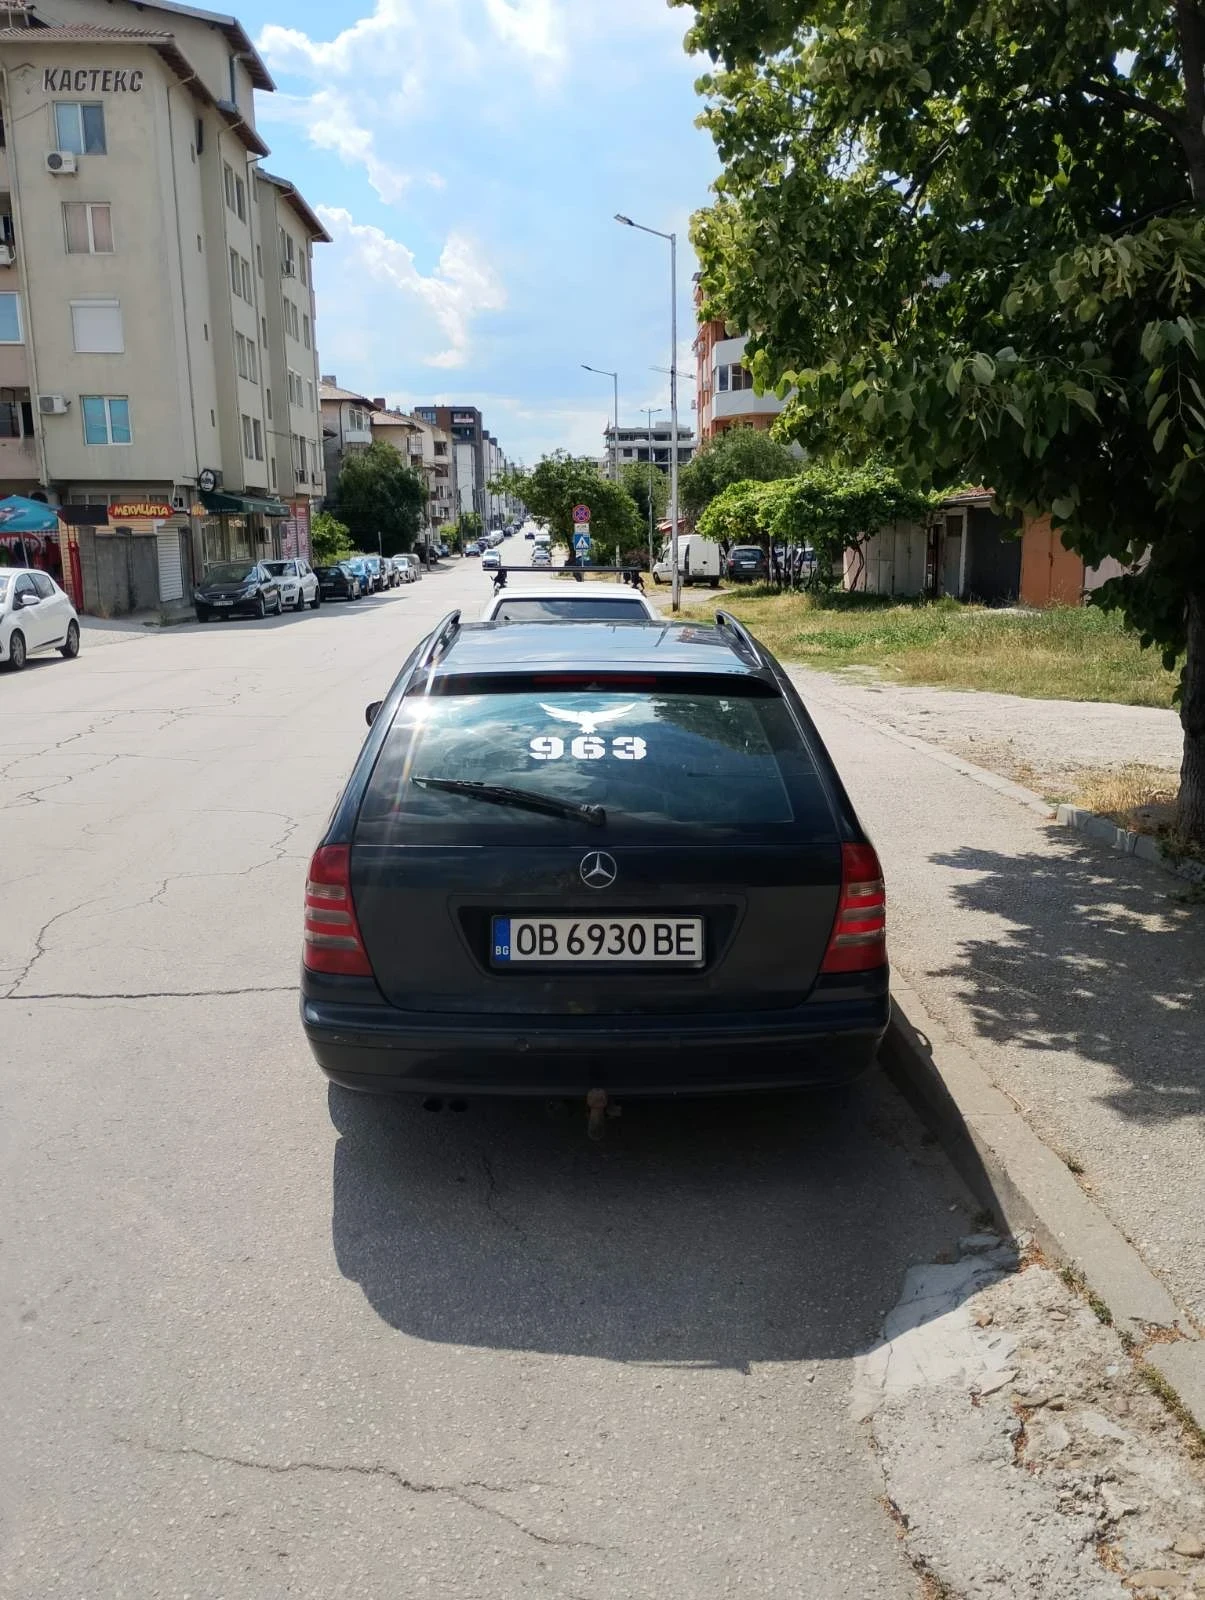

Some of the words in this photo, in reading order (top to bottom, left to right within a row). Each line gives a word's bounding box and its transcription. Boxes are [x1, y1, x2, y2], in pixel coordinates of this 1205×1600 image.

[44, 68, 144, 92] КАСТЕКС
[529, 736, 647, 760] 963
[495, 945, 509, 956] BG
[516, 923, 559, 955] OB
[566, 923, 646, 955] 6930
[653, 923, 696, 955] BE
